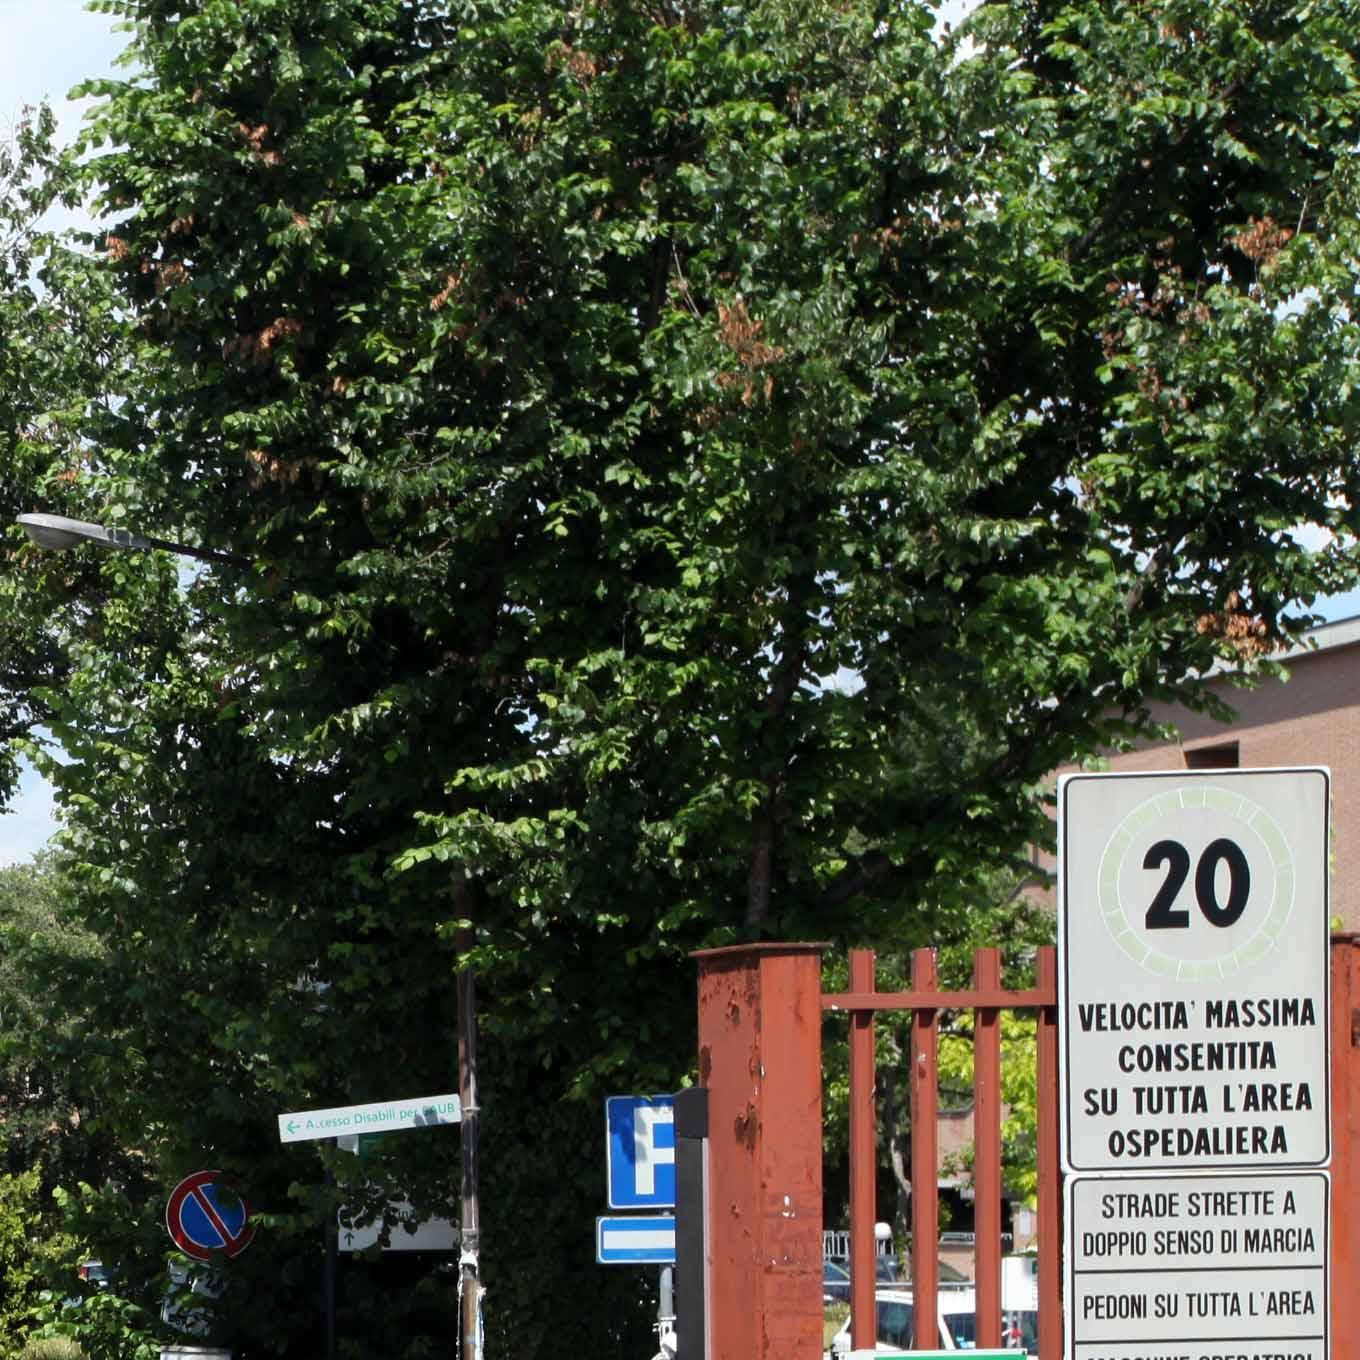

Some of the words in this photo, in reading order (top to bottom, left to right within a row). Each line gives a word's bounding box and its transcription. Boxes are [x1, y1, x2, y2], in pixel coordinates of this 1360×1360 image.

[1142, 838, 1250, 929] 20
[1078, 1001, 1195, 1032] VELOCITA'
[1205, 998, 1316, 1029] MASSIMA
[1118, 1042, 1277, 1072] CONSENTITA
[1084, 1088, 1118, 1115] SU
[1133, 1085, 1208, 1114] TUTTA
[1223, 1083, 1312, 1112] L'AREA
[354, 1109, 396, 1124] Disabili
[1108, 1126, 1288, 1157] OSPEDALIERA
[1101, 1193, 1179, 1218] STRADE
[1187, 1191, 1274, 1217] STRETTE
[1283, 1190, 1296, 1215] A
[1083, 1231, 1146, 1256] DOPPIO
[1154, 1230, 1214, 1255] SENSO
[1221, 1229, 1237, 1254] DI
[1244, 1228, 1315, 1253] MARCIA
[1083, 1294, 1147, 1320] PEDONI
[1154, 1293, 1178, 1318] SU
[1186, 1292, 1241, 1317] TUTTA
[1249, 1290, 1315, 1316] L'AREA
